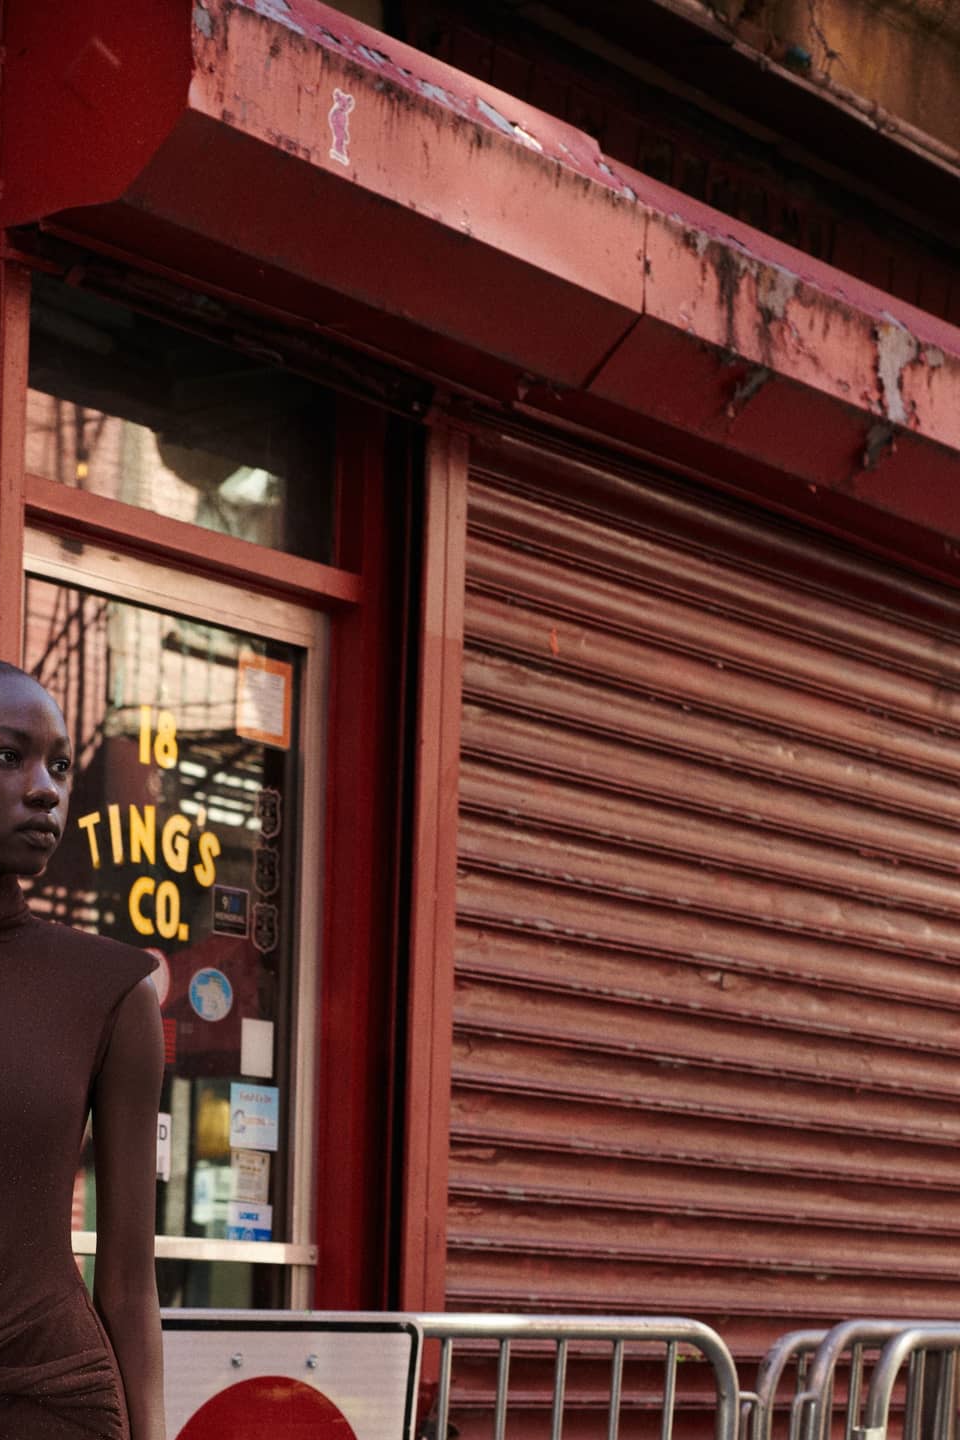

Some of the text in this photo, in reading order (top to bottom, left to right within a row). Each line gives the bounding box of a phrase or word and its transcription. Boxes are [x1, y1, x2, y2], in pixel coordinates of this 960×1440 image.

[139, 705, 178, 768] 18
[77, 803, 221, 887] TING'S
[128, 876, 189, 941] CO.
